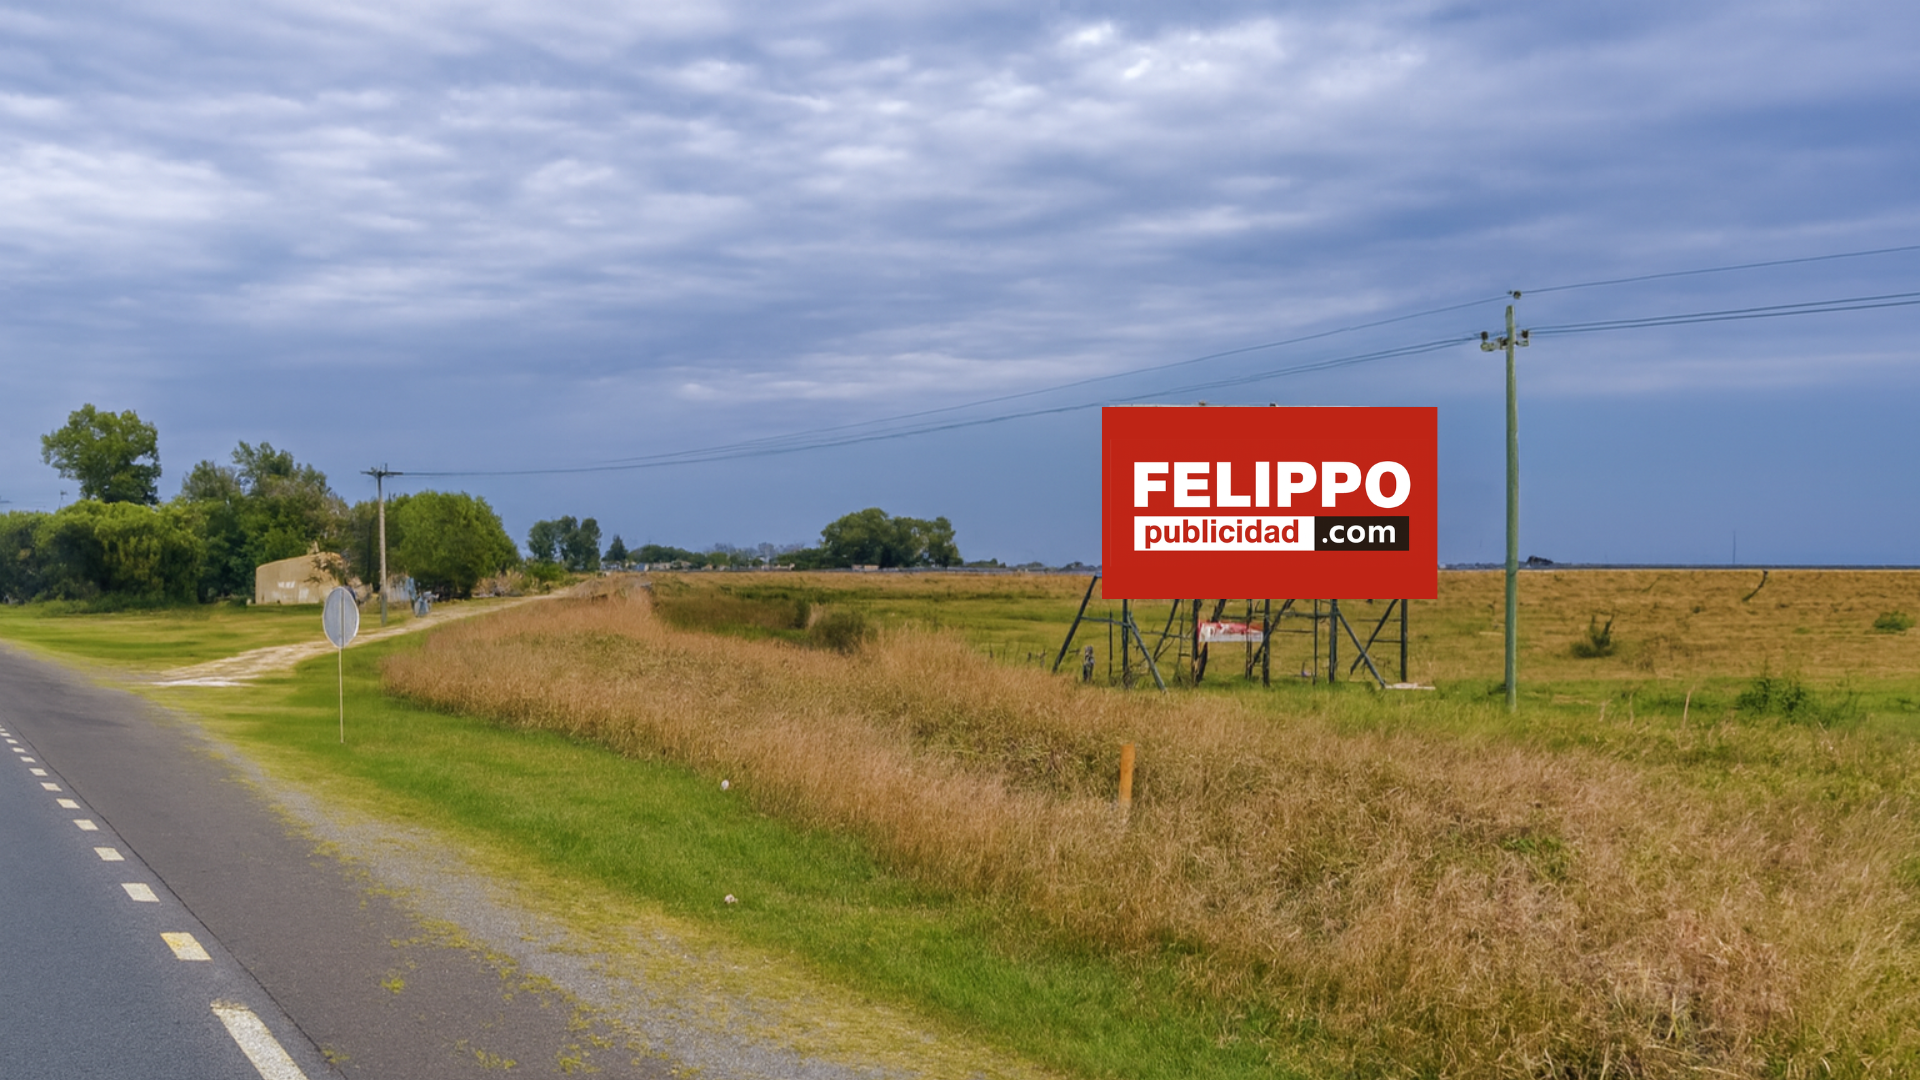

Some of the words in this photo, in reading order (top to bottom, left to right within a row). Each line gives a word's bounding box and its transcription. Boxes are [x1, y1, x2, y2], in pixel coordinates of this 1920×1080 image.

[1133, 460, 1411, 509] FELIPPO
[1144, 519, 1300, 549] publicidad
[1321, 524, 1397, 544] .com
